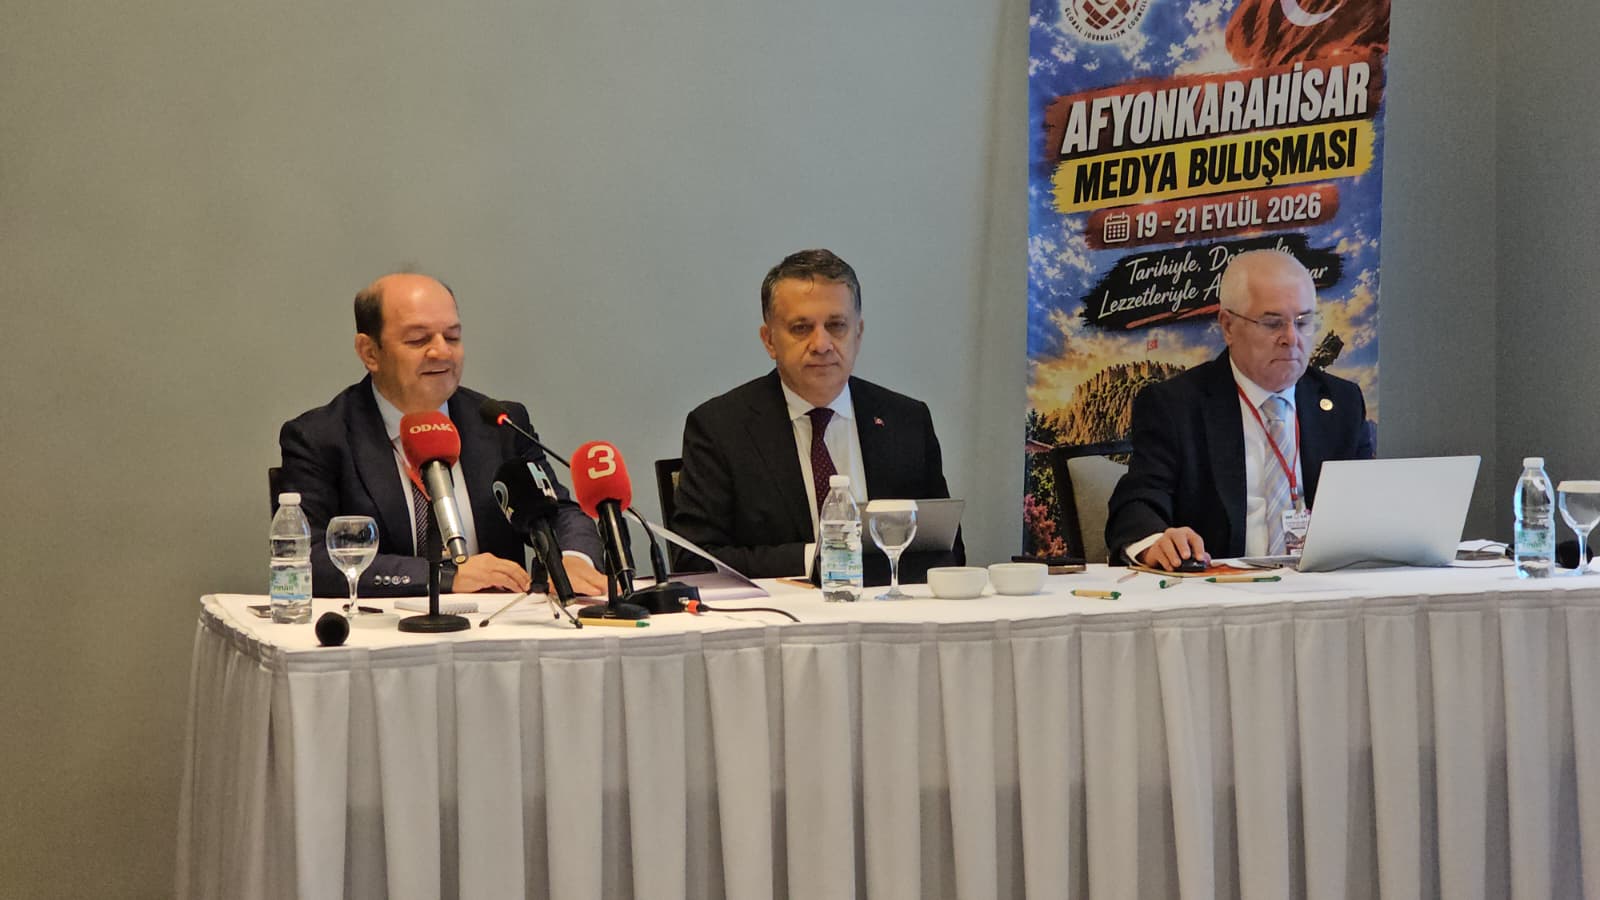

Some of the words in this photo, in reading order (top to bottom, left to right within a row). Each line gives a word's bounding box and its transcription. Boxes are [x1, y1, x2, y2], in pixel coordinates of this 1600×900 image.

[1064, 7, 1083, 33] GLOBAL
[1061, 62, 1370, 154] AFYONKARAHİSAR
[1073, 151, 1178, 204] MEDYA
[1188, 128, 1358, 185] BULUŞMASI
[1135, 211, 1158, 239] 19
[1174, 206, 1197, 234] 21
[1201, 195, 1262, 232] EYLÜL
[1267, 192, 1321, 224] 2026
[1125, 250, 1201, 285] Tarihiyle,
[1098, 279, 1199, 319] Lezzetleriyle
[409, 423, 454, 434] ODAK
[587, 445, 617, 479] 3
